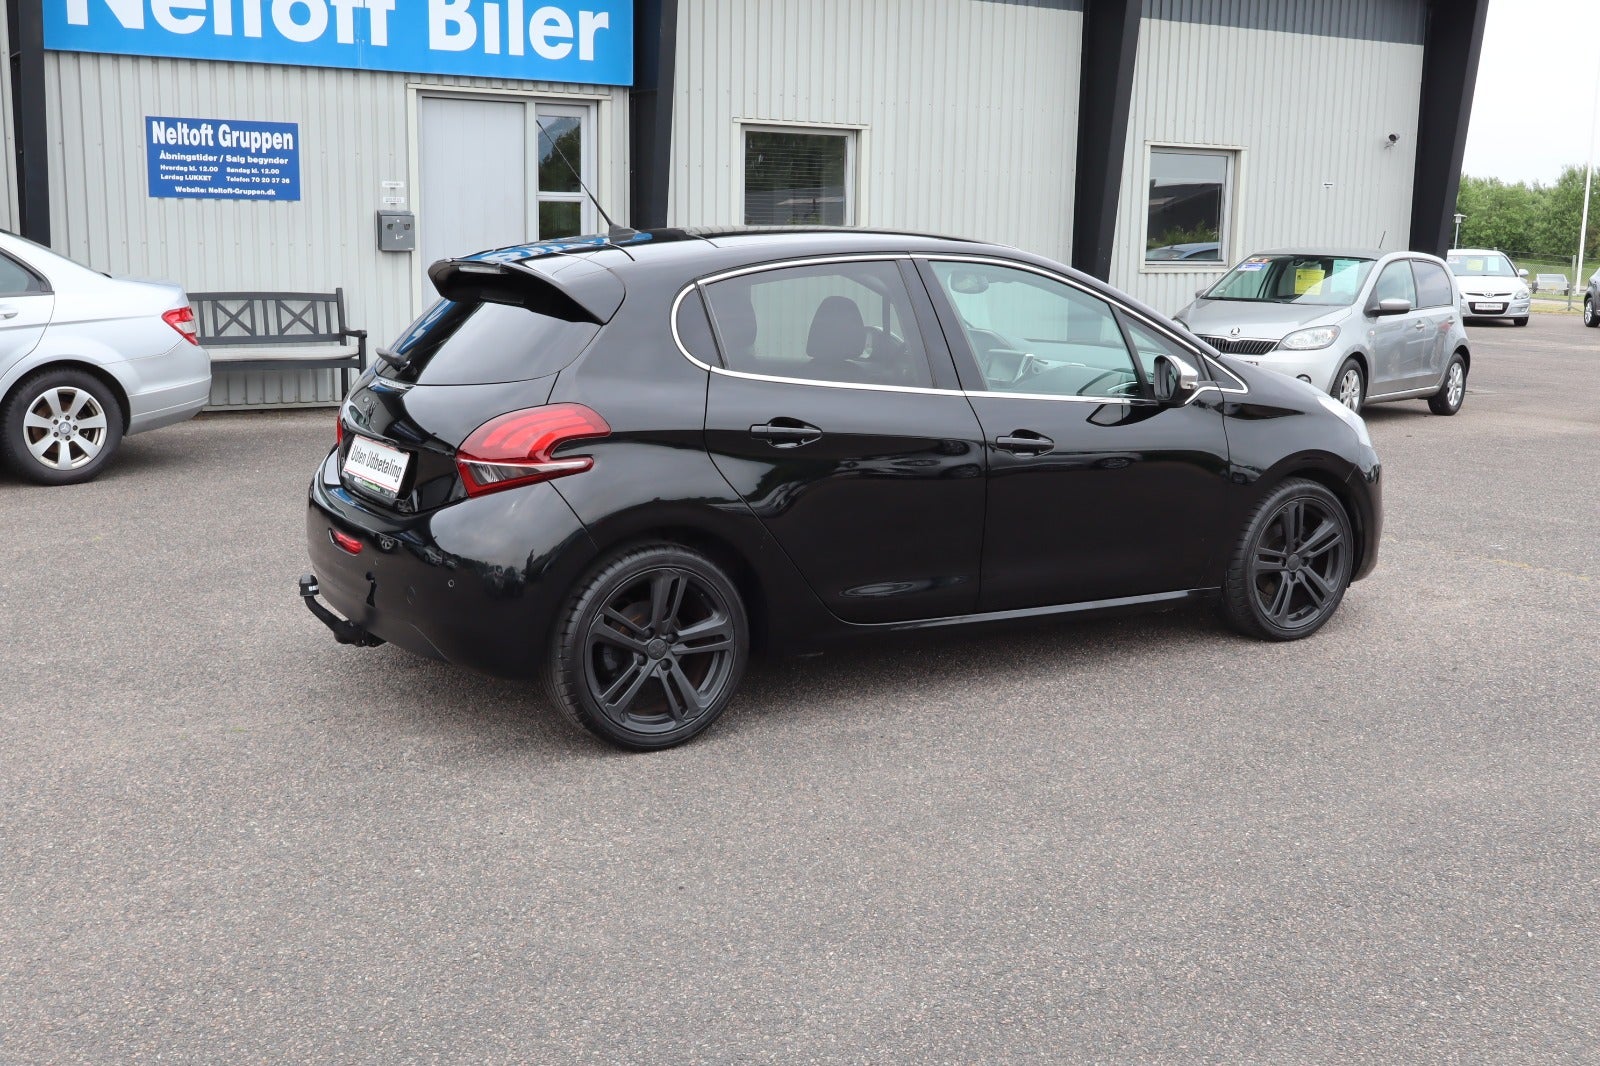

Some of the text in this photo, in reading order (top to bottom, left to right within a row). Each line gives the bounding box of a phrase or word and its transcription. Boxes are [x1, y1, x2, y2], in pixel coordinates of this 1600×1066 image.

[428, 0, 609, 61] Biler
[152, 120, 294, 153] Neltoft Gruppen
[159, 150, 218, 162] Åbningstider
[225, 154, 246, 164] Salg
[247, 155, 289, 165] begynder
[160, 164, 188, 172] Hverdag
[226, 166, 251, 175] Søndag
[160, 173, 184, 181] Lørdag
[226, 175, 250, 183] Telefon
[261, 176, 271, 184] 20
[174, 185, 276, 196] Website: Neltoft-Gruppen.dk
[350, 444, 402, 483] Uden Udbetaling
